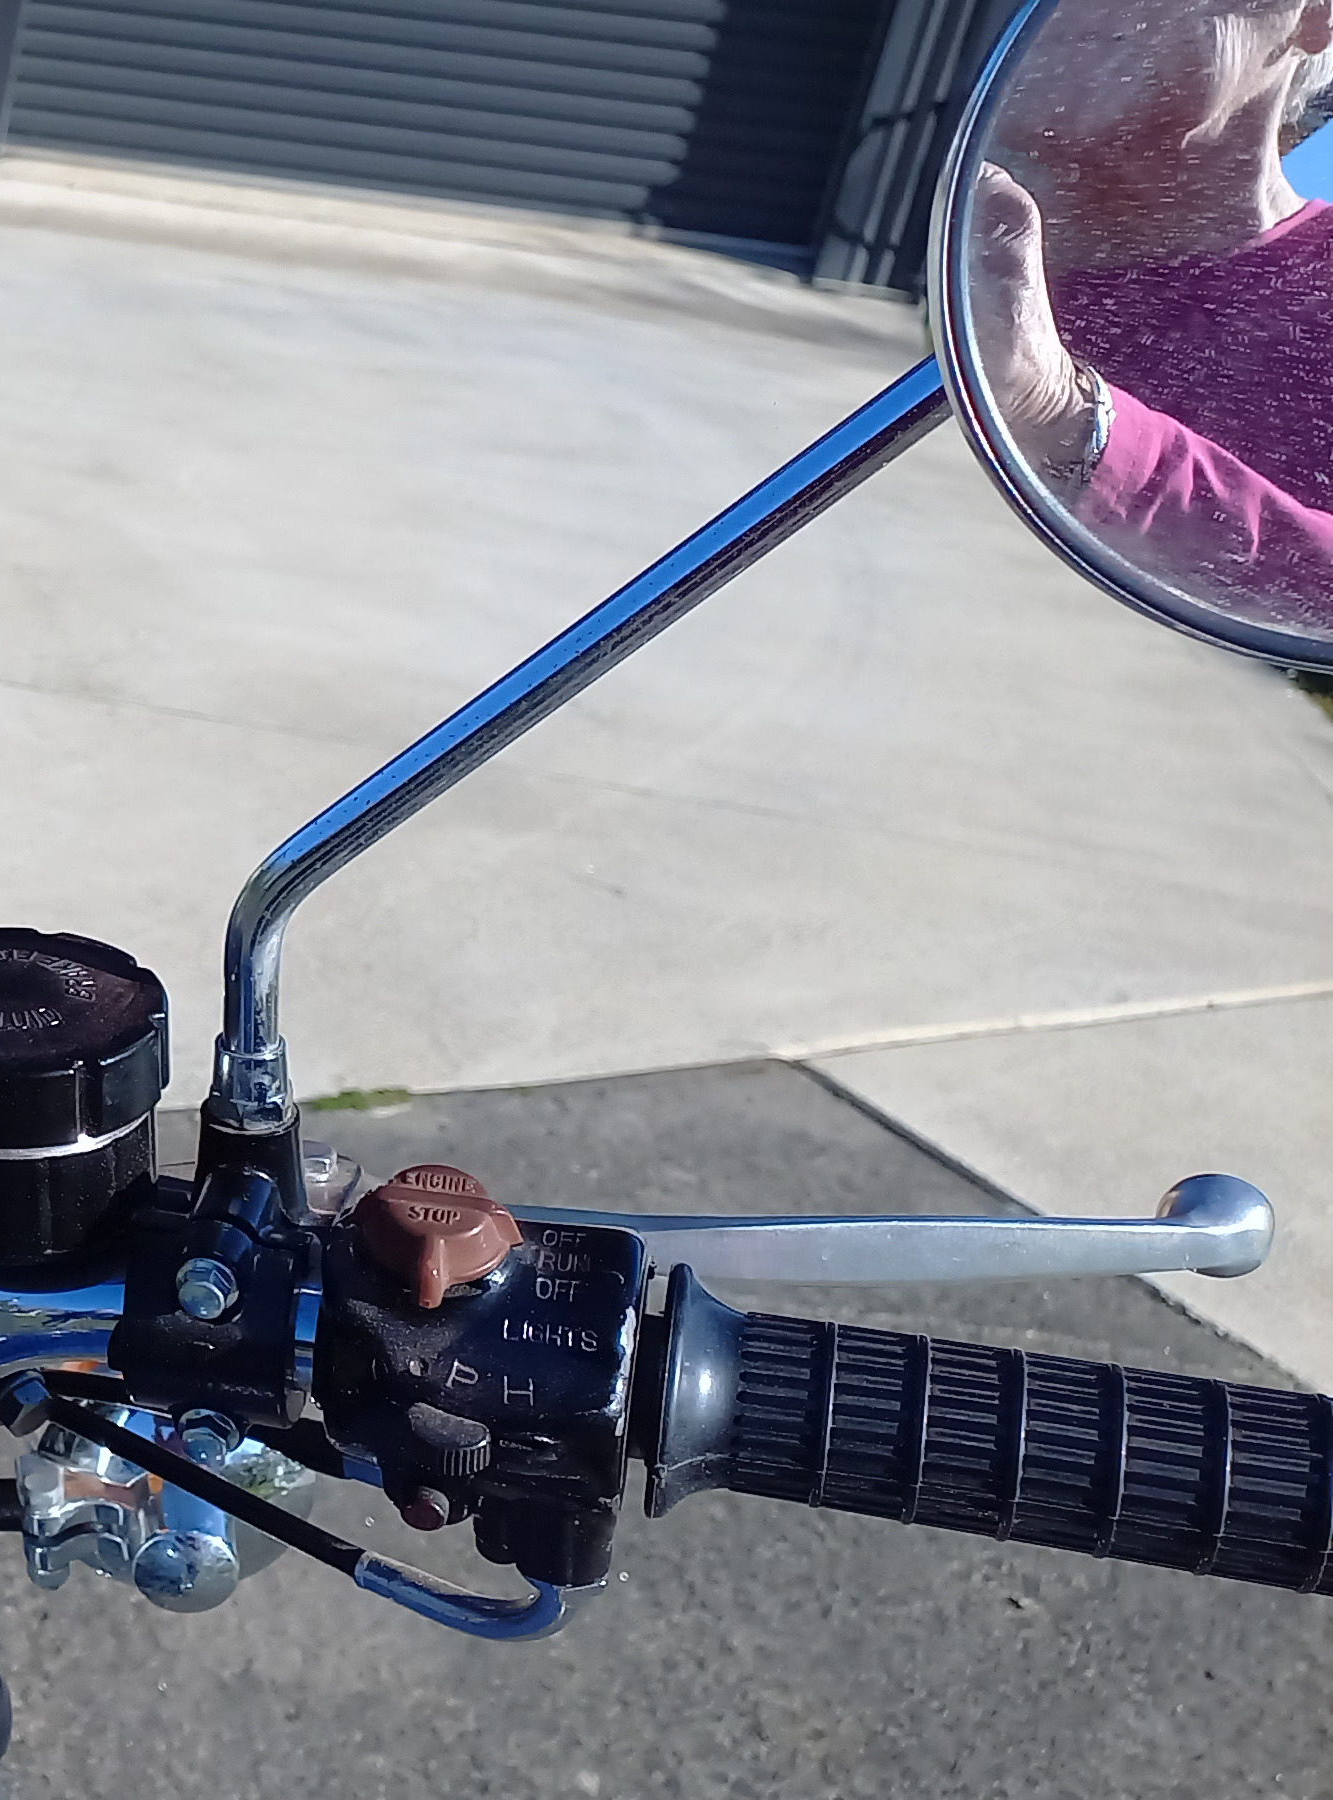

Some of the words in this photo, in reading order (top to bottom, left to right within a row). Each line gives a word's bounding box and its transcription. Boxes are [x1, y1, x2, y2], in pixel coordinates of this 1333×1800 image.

[407, 1206, 461, 1226] STOP
[542, 1229, 587, 1246] OFF
[538, 1250, 590, 1273] RUN
[536, 1277, 582, 1302] OFF
[502, 1317, 599, 1352] LIGHTS
[445, 1358, 480, 1389] P
[503, 1374, 535, 1407] H
